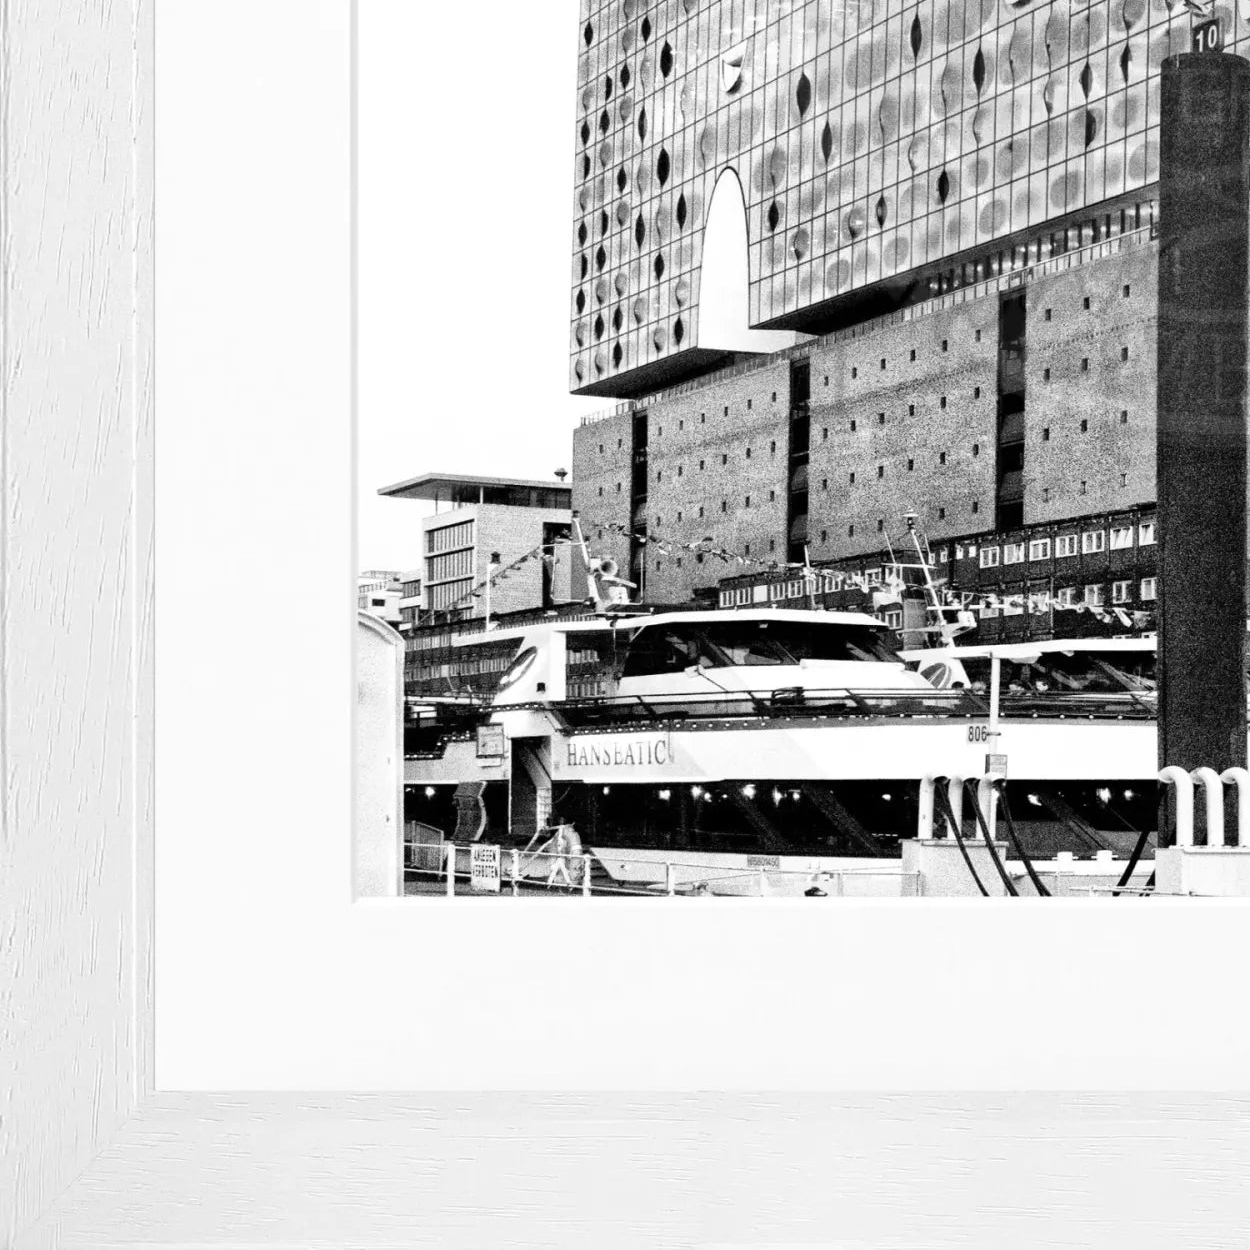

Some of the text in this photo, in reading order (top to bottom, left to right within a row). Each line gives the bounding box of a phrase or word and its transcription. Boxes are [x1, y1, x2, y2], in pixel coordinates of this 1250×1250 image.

[1195, 24, 1218, 53] 10
[968, 725, 988, 742] 806
[566, 738, 667, 767] HANSEATIC
